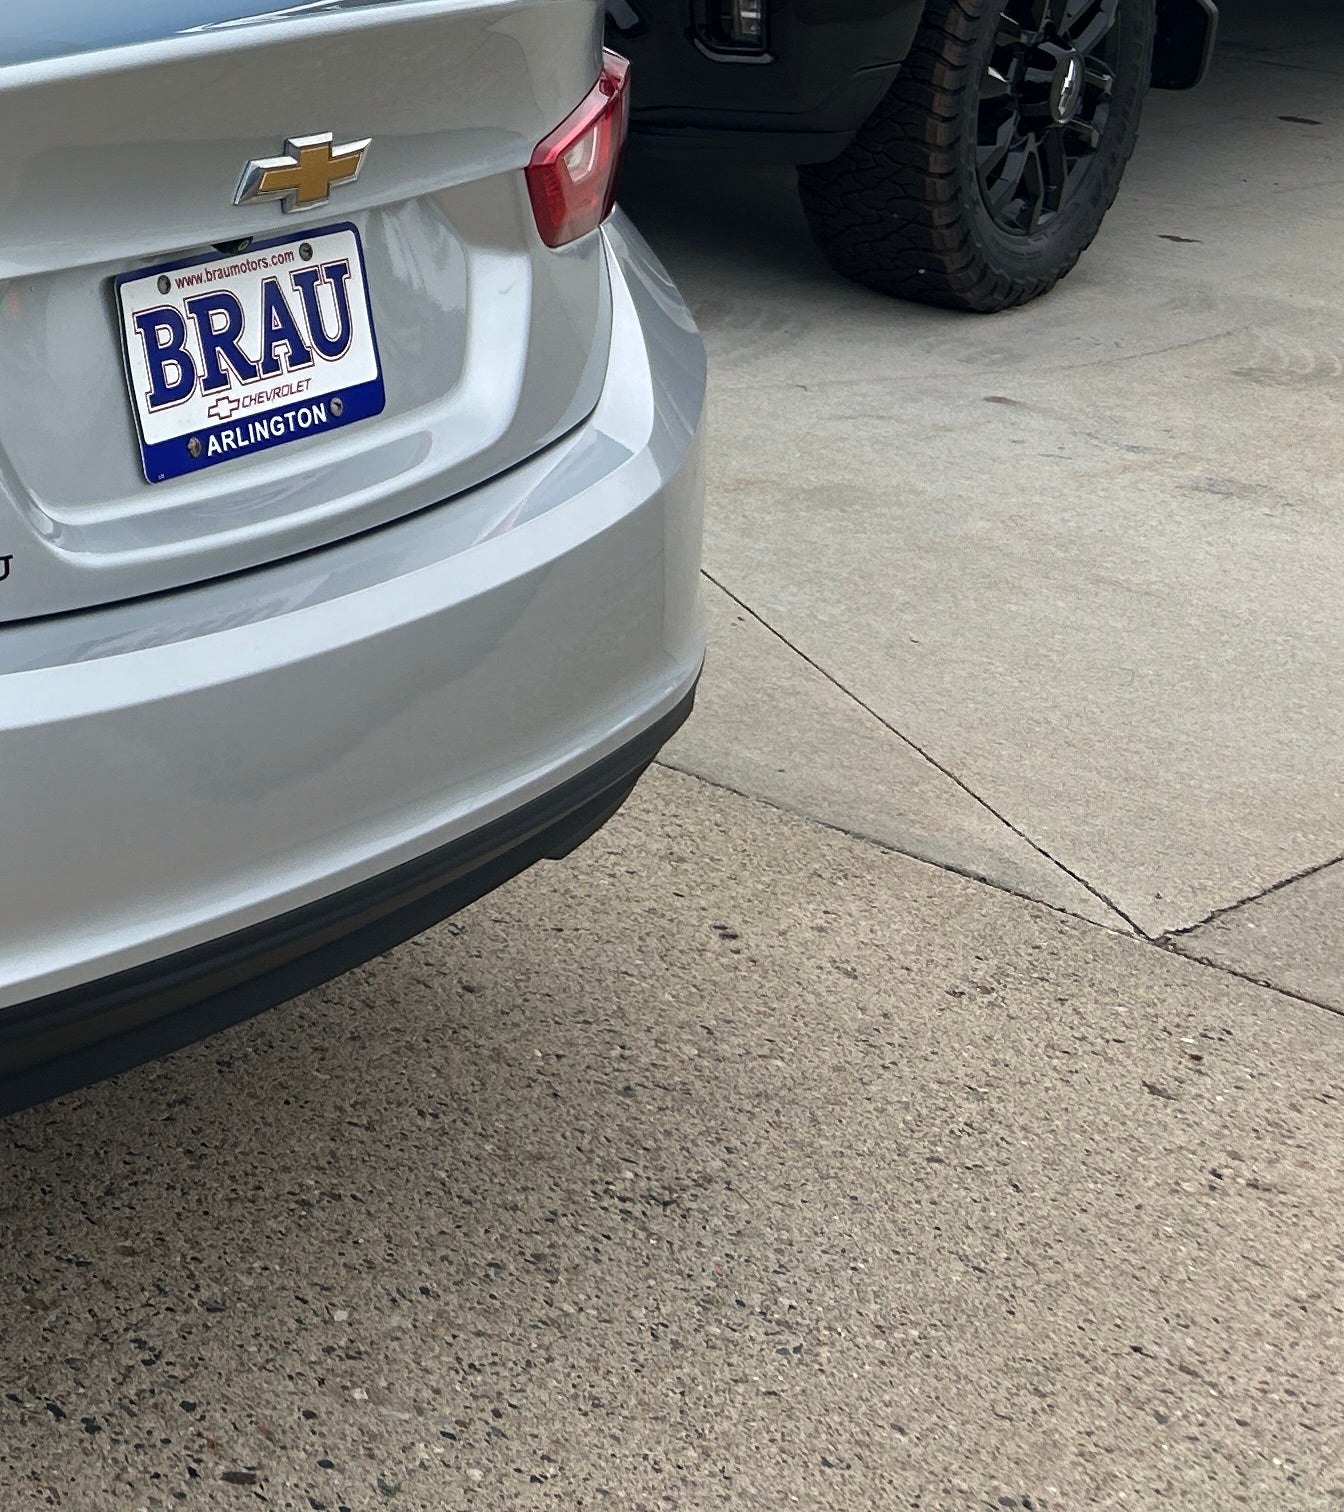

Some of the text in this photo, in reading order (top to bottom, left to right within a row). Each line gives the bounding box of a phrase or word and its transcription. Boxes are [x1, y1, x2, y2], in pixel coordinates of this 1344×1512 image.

[174, 249, 295, 290] www.braumotors.com
[132, 257, 354, 414] BRAU
[241, 377, 313, 409] CHEVROLET
[206, 402, 328, 458] ARLINGTON
